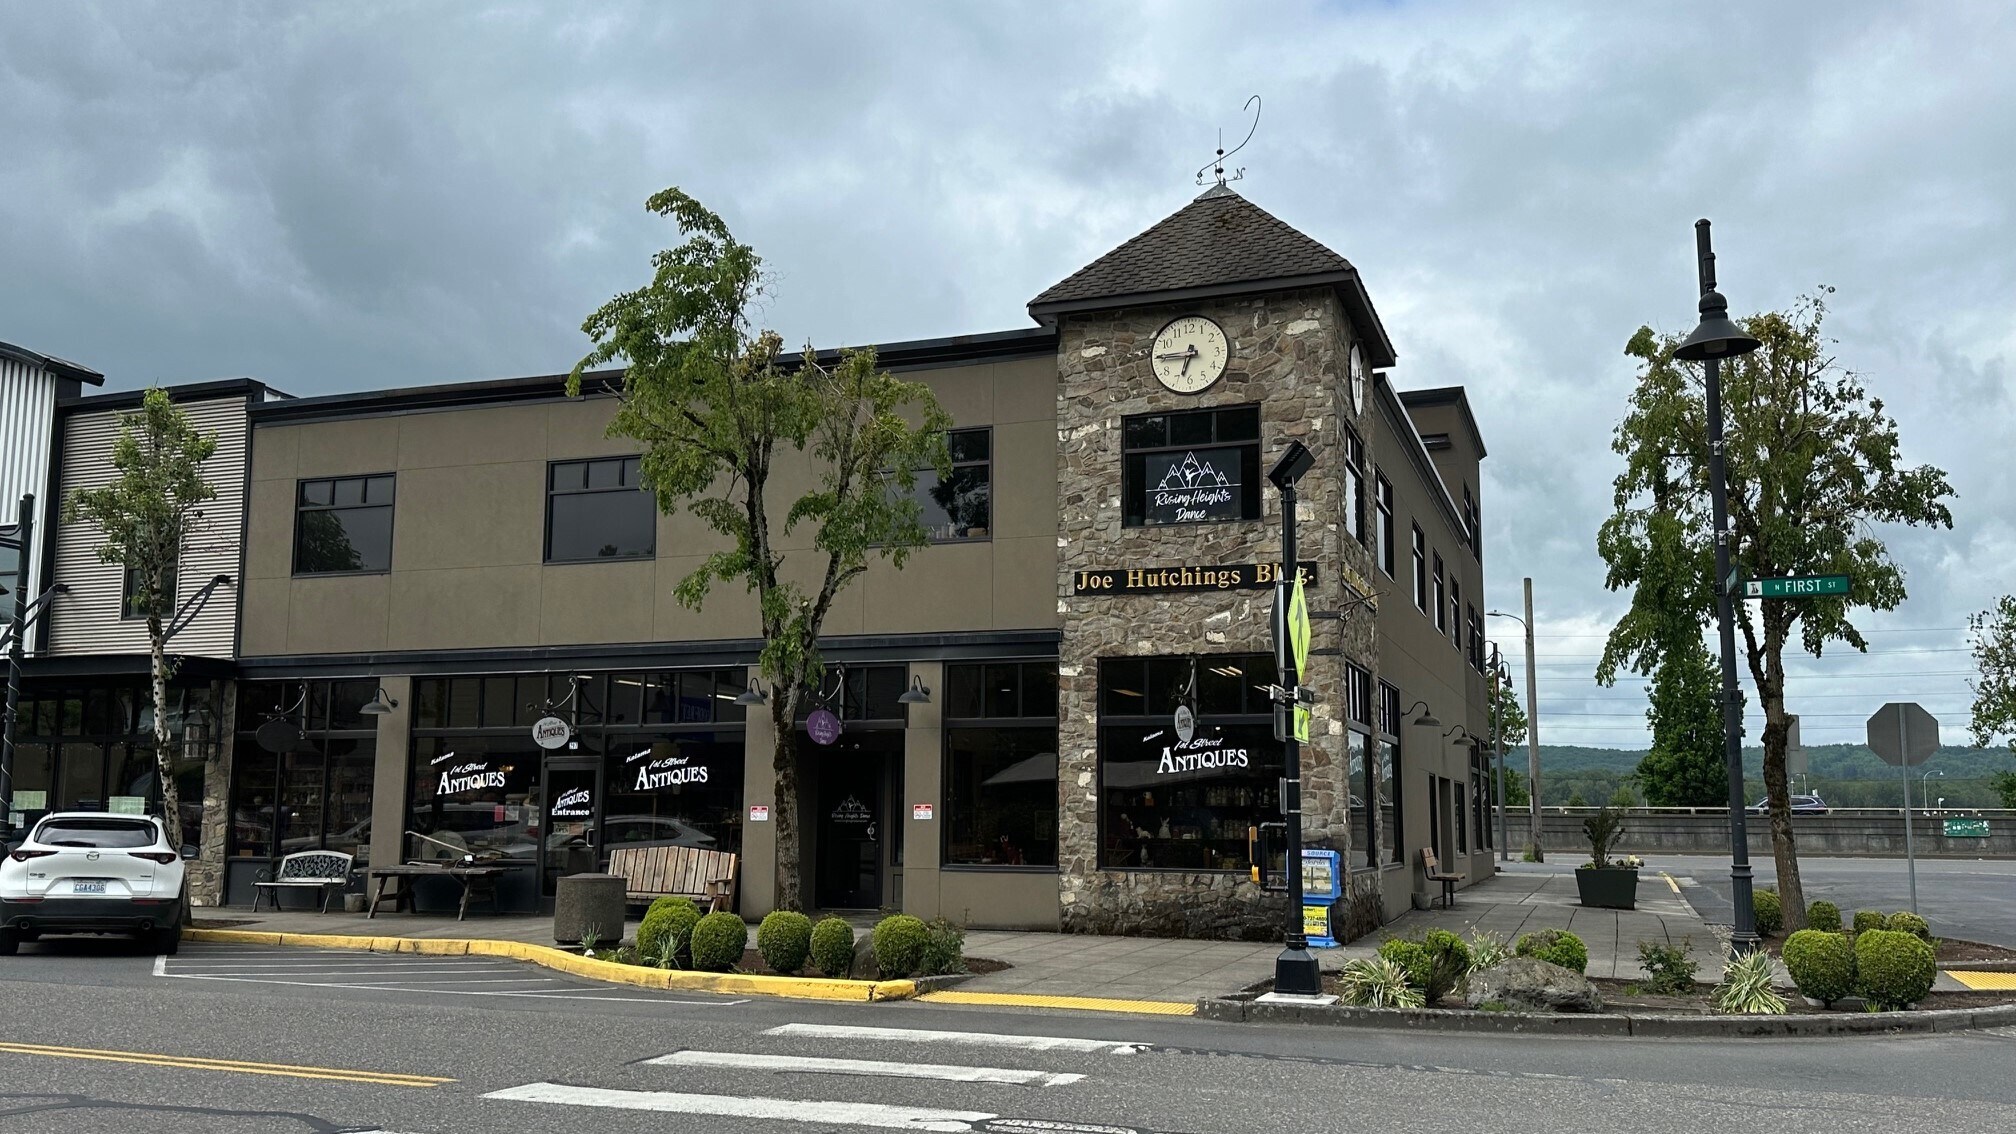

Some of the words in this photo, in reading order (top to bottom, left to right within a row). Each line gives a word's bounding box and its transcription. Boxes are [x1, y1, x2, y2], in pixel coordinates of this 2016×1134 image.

[1173, 328, 1181, 338] 11
[1184, 323, 1195, 334] 12
[1200, 325, 1204, 334] 1
[1163, 339, 1172, 349] 10
[1208, 333, 1215, 343] 2
[1214, 347, 1220, 357] 3
[1163, 366, 1170, 376] 8
[1210, 361, 1216, 370] 4
[1174, 375, 1180, 383] 7
[1187, 375, 1193, 385] 6
[1200, 371, 1206, 381] 5
[1155, 491, 1190, 507] Rising
[1190, 488, 1232, 506] Heights
[1175, 507, 1207, 521] Dance
[1077, 571, 1114, 590] Joe
[1126, 567, 1241, 588] Hutchings
[1255, 562, 1314, 584] Blg.
[1785, 580, 1822, 593] FIRST
[1828, 581, 1836, 589] ST
[537, 725, 565, 739] ANTIQUES
[1174, 740, 1190, 751] 1st
[1189, 737, 1223, 750] Street
[648, 759, 662, 770] 1st
[661, 756, 689, 768] Street
[1156, 746, 1249, 774] ANTIQUES
[450, 765, 463, 775] 1st
[461, 762, 488, 774] Street
[436, 771, 506, 795] ANTIQUES
[634, 765, 708, 791] ANTIQUES
[555, 790, 590, 810] ANTIQUES
[551, 808, 590, 816] Entrance
